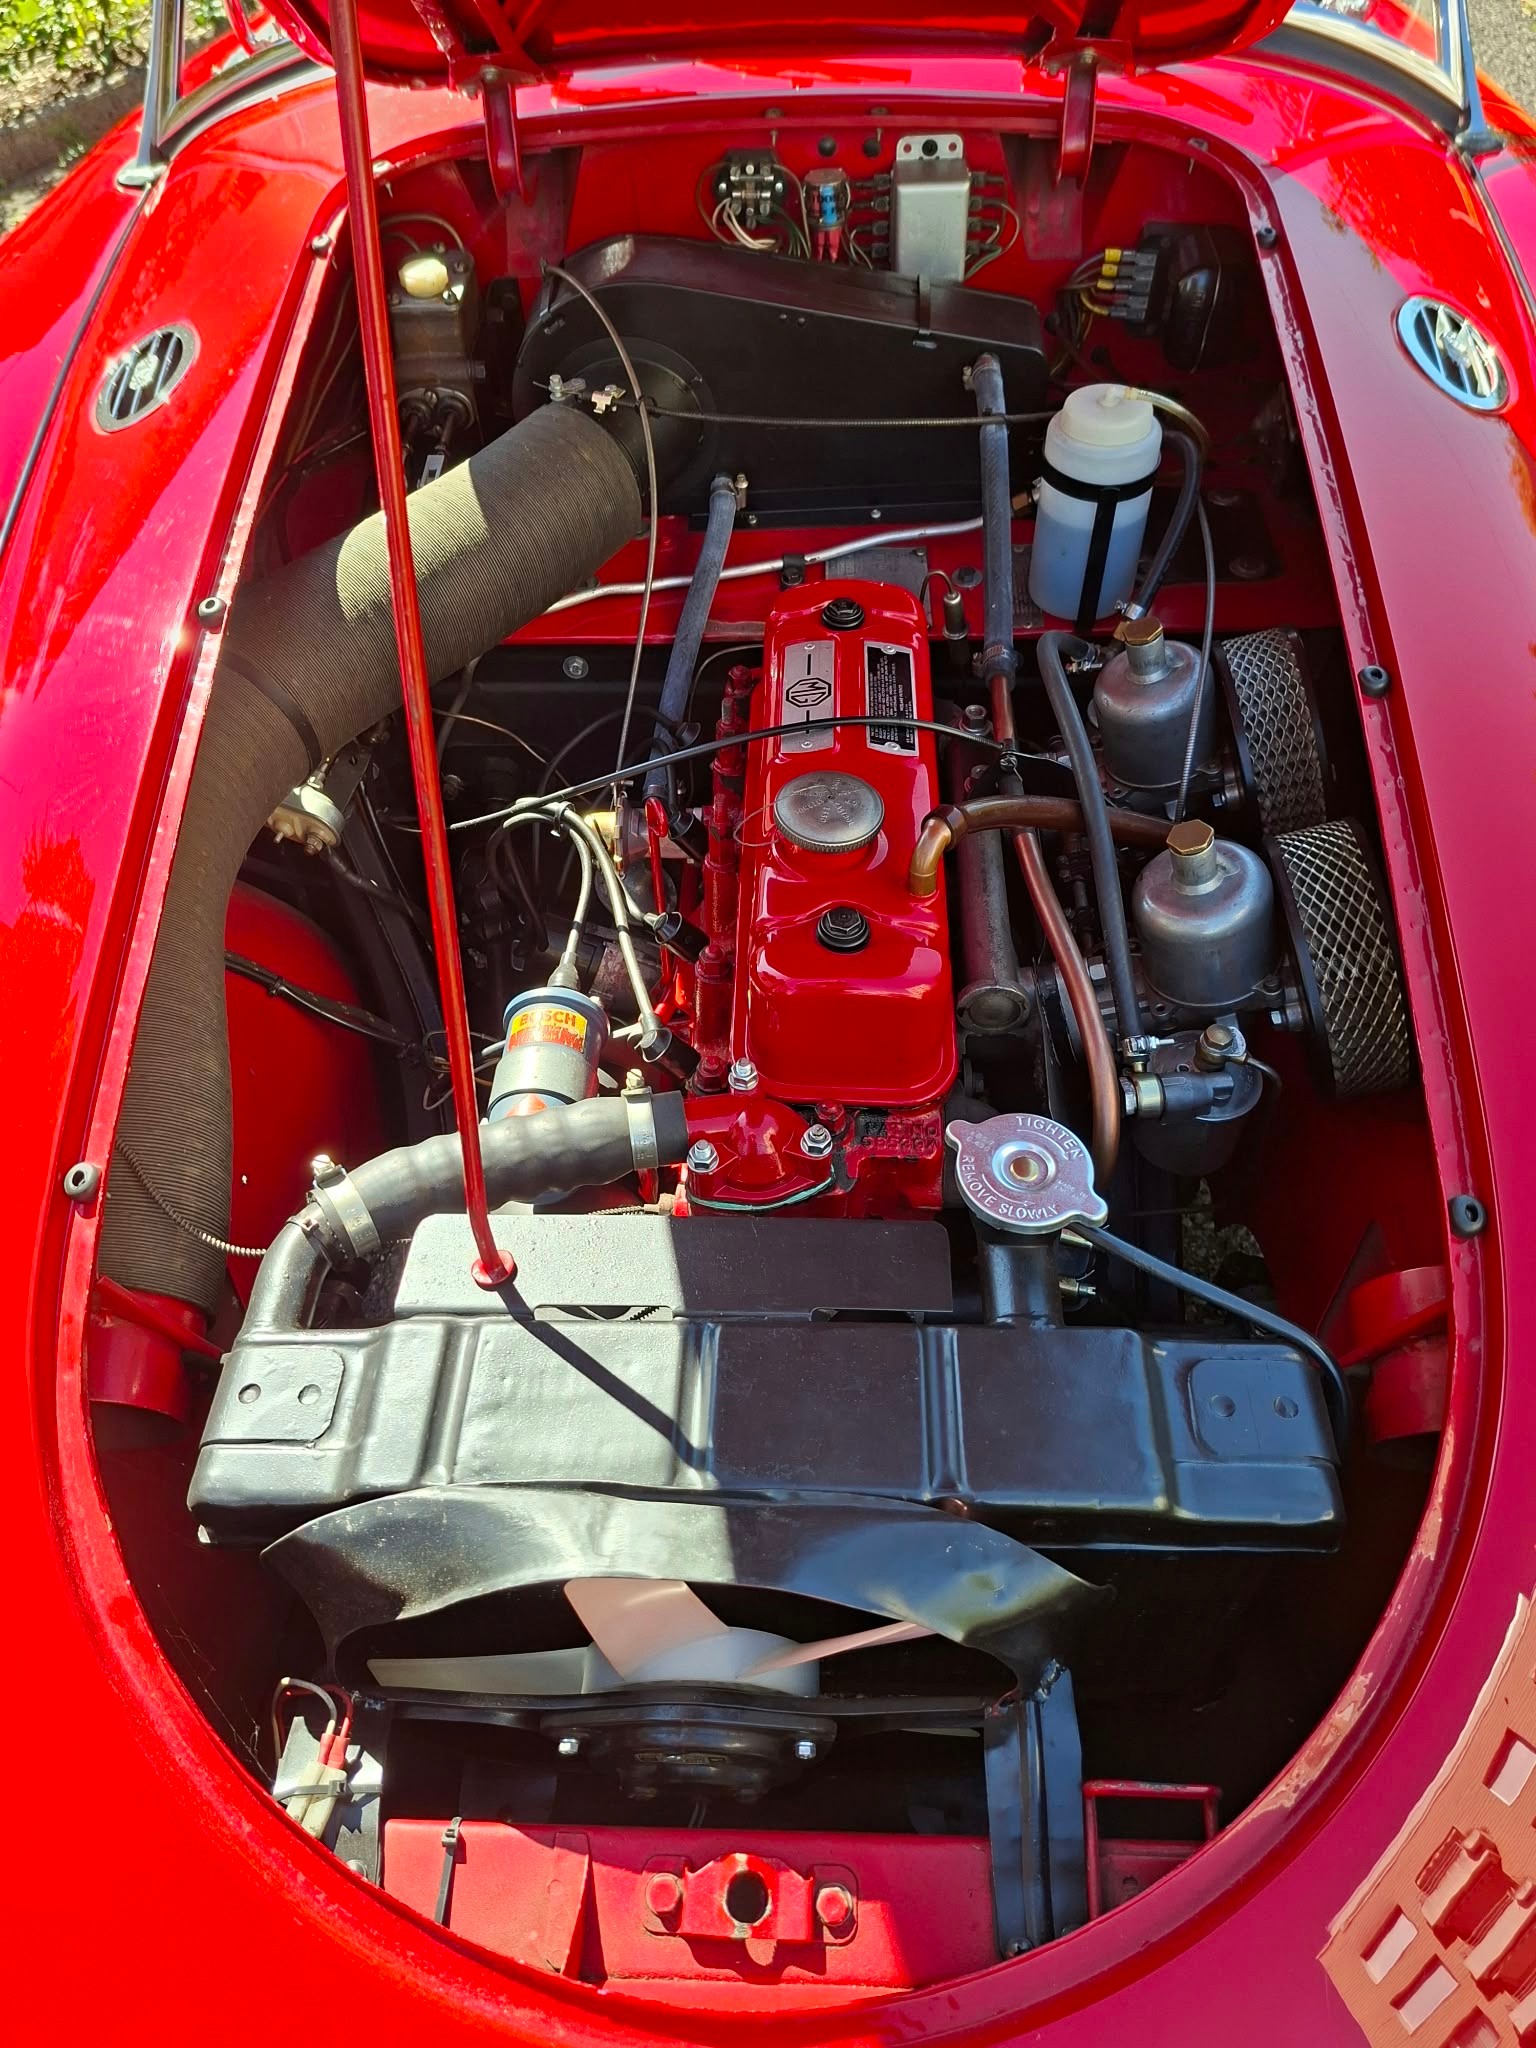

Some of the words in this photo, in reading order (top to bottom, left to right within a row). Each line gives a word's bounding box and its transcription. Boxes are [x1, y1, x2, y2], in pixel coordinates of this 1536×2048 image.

[789, 680, 828, 705] MG
[1016, 1115, 1085, 1159] TIGHTEN
[962, 1154, 998, 1208] REMOVE
[998, 1203, 1061, 1220] SLOWLY
